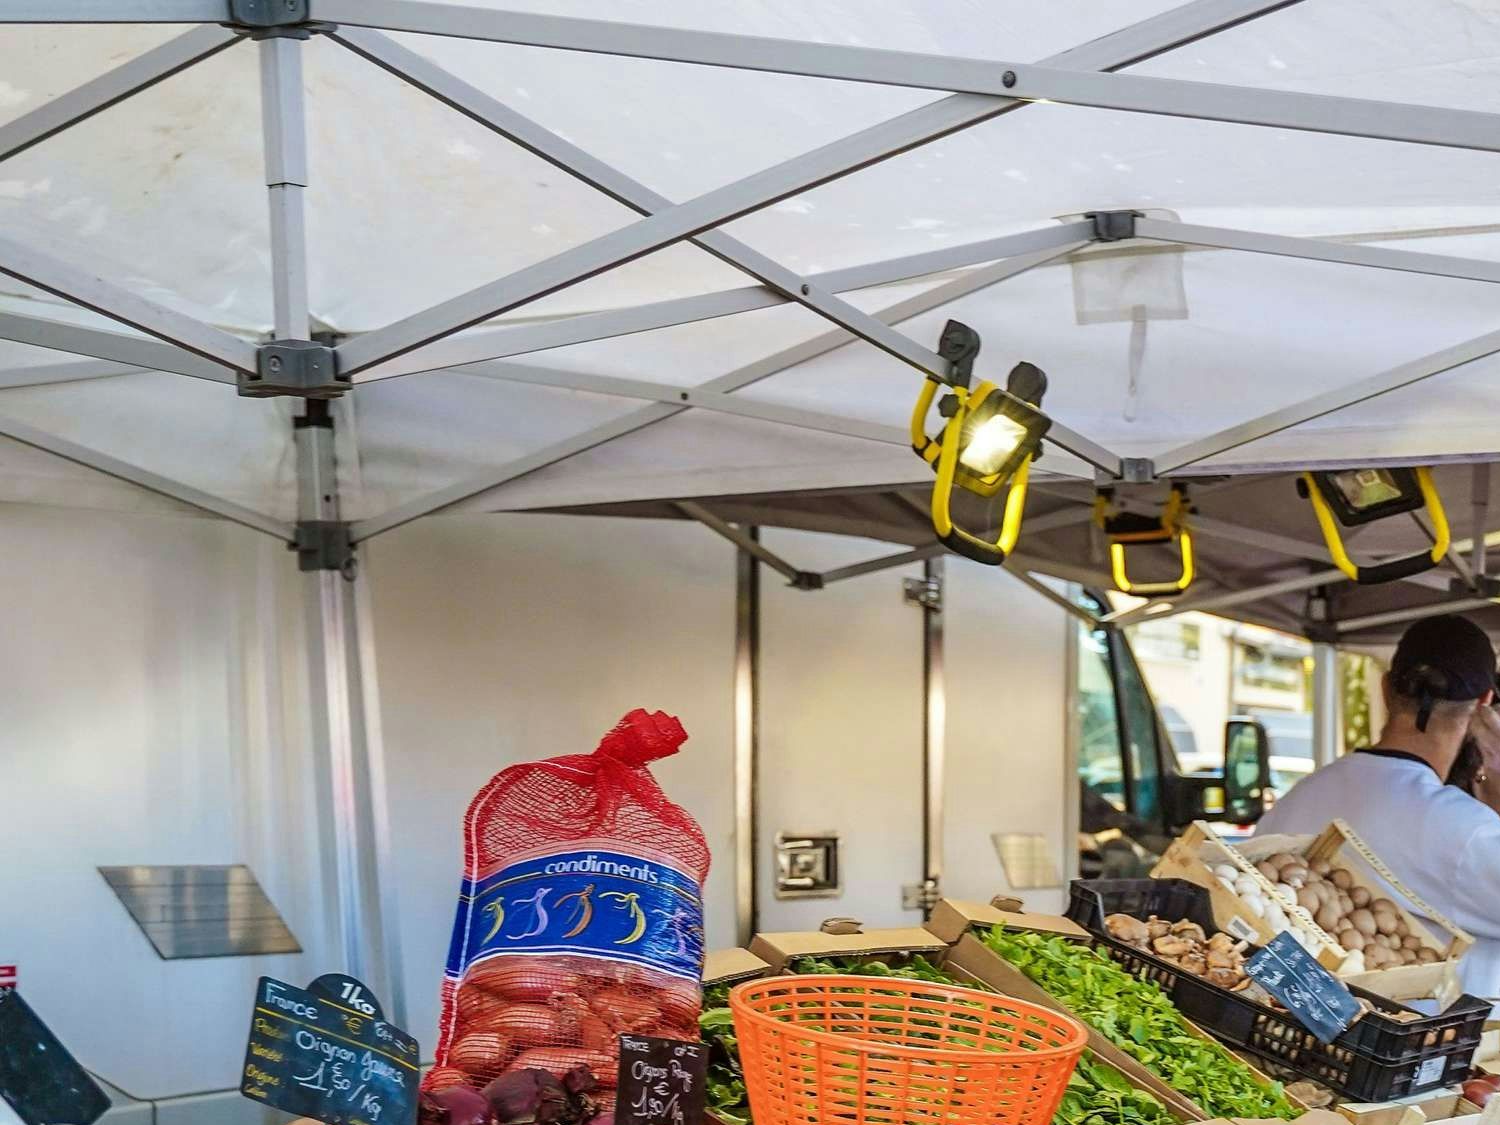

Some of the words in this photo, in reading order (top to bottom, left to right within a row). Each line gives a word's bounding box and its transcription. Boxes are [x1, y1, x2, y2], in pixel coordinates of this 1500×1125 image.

[545, 855, 658, 884] condiments
[265, 982, 318, 1020] France
[295, 1030, 356, 1062] Oignon
